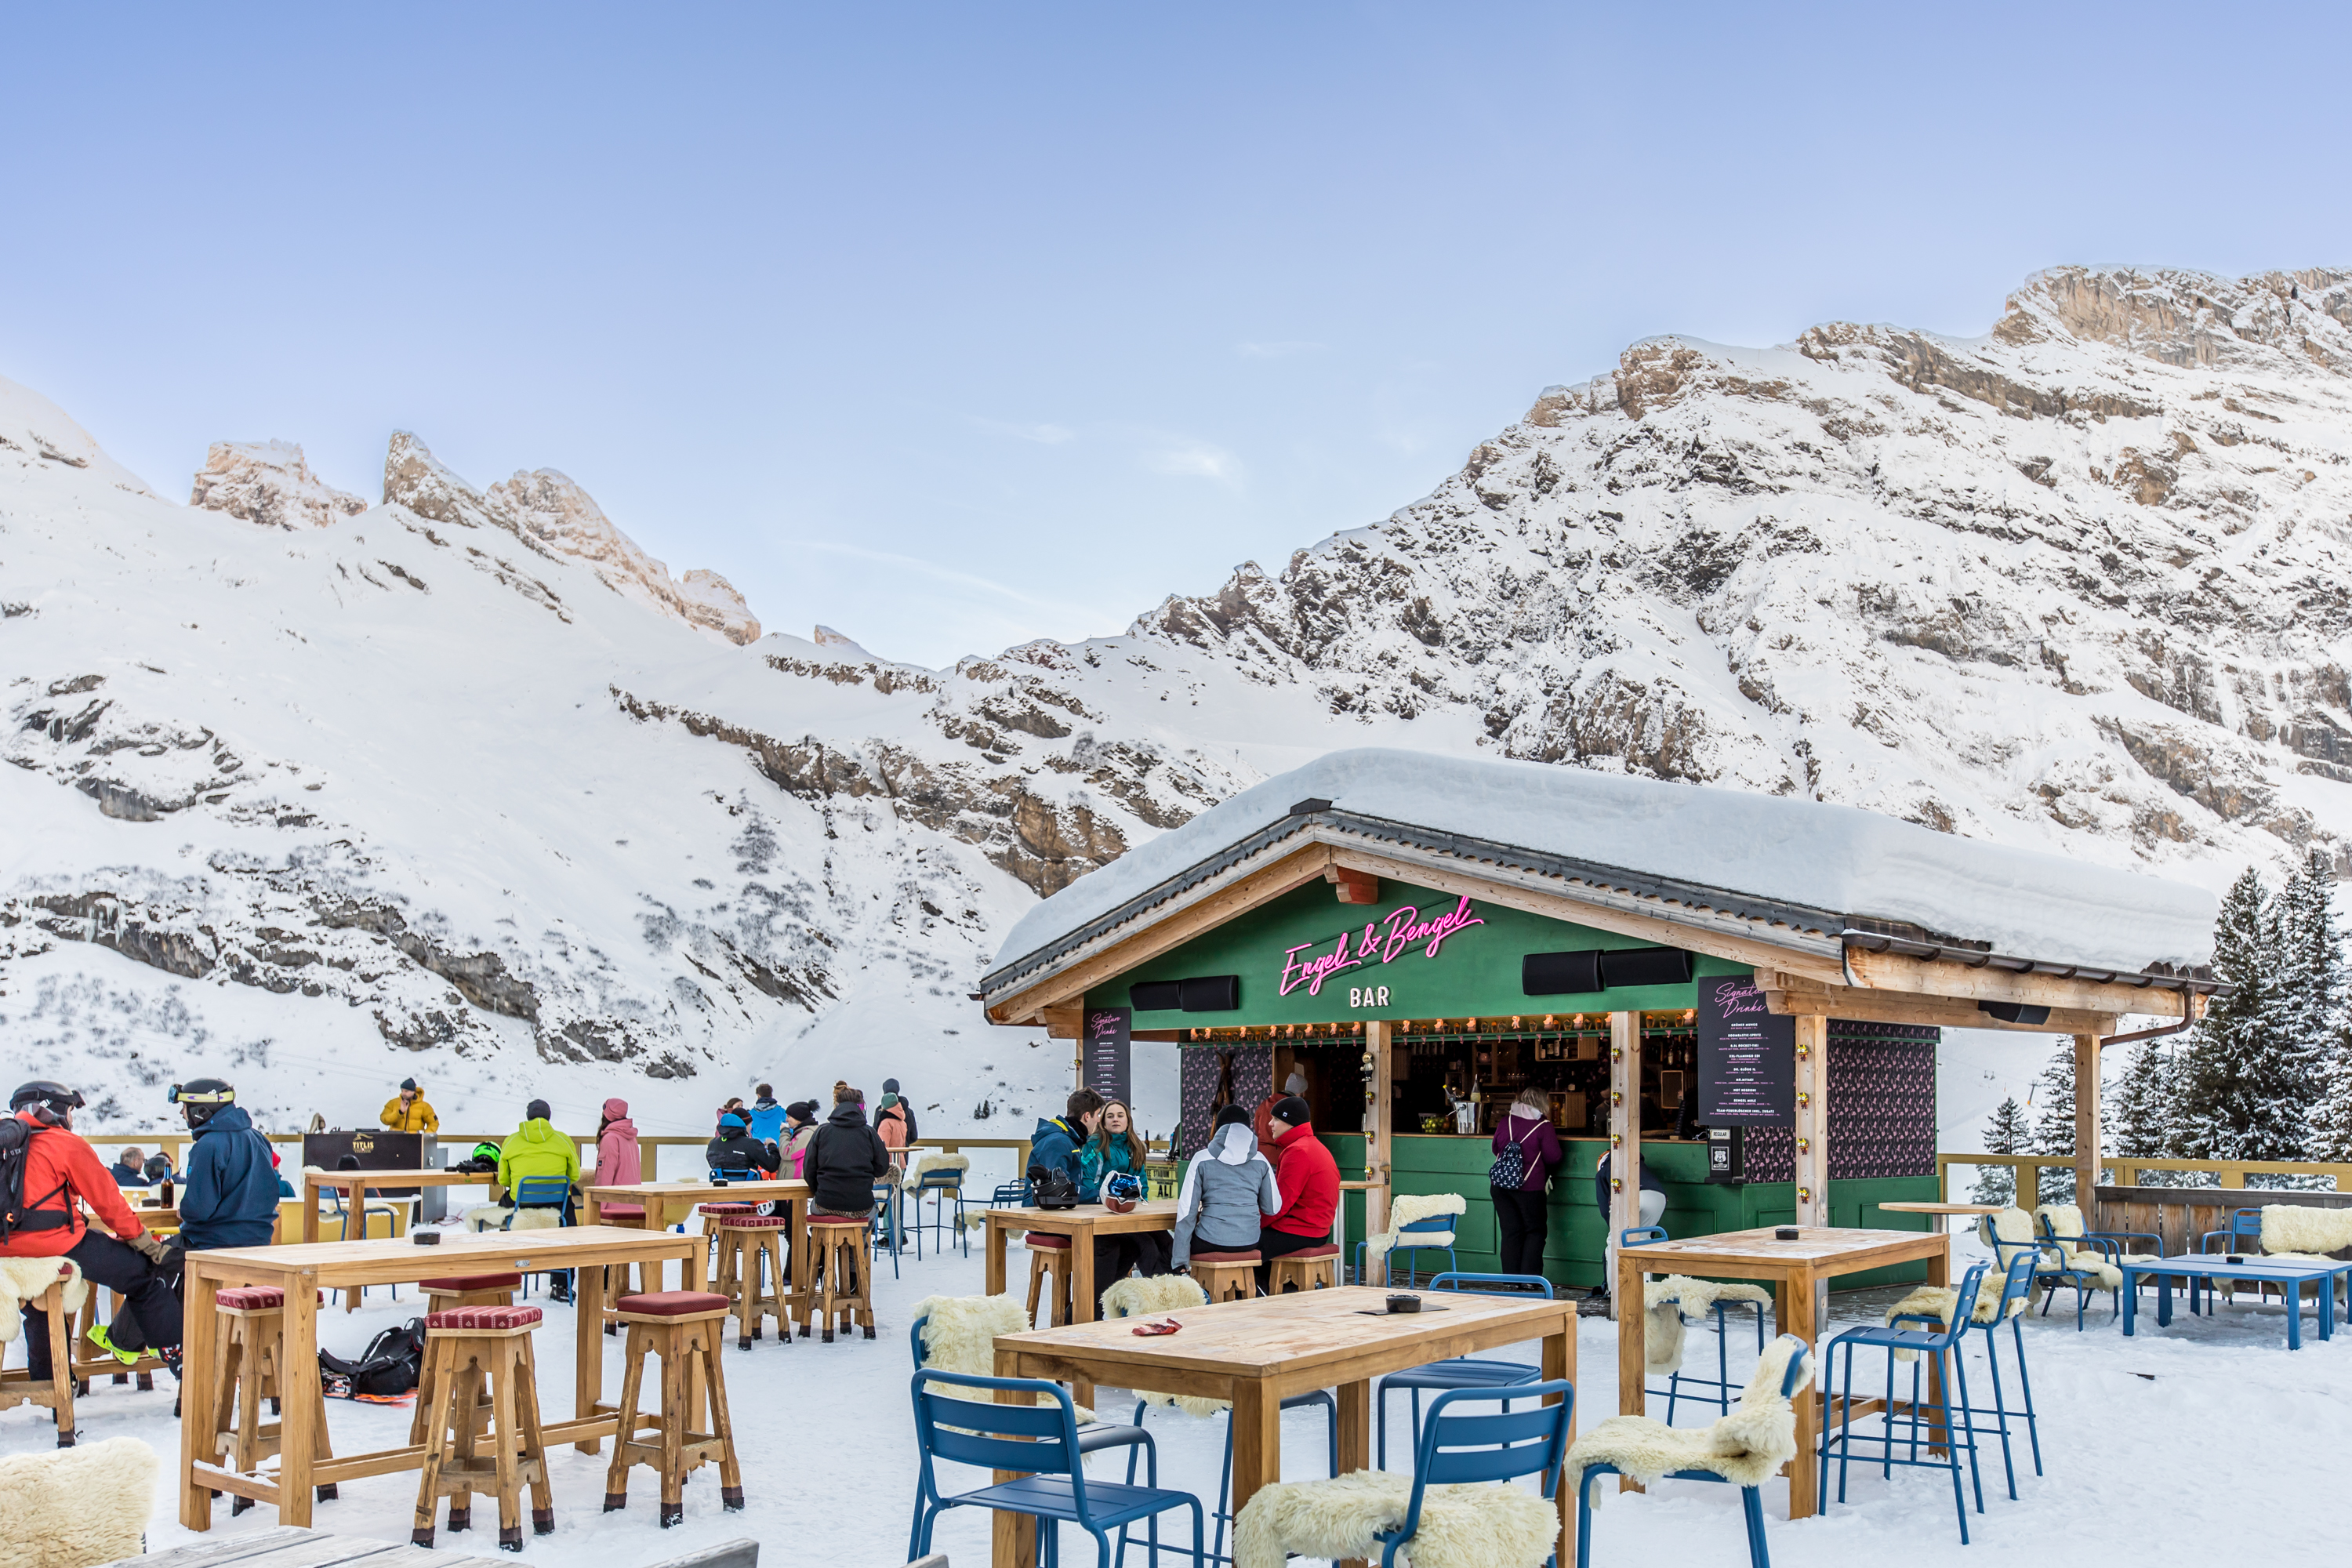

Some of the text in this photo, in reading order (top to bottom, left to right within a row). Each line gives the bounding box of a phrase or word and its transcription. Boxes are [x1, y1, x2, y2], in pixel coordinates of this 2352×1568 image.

[1279, 895, 1484, 996] Engel & Bengel
[1349, 985, 1389, 1008] BAR
[1719, 999, 1766, 1018] Drinks
[1091, 1013, 1121, 1029] Signature
[1093, 1025, 1117, 1039] Drinks
